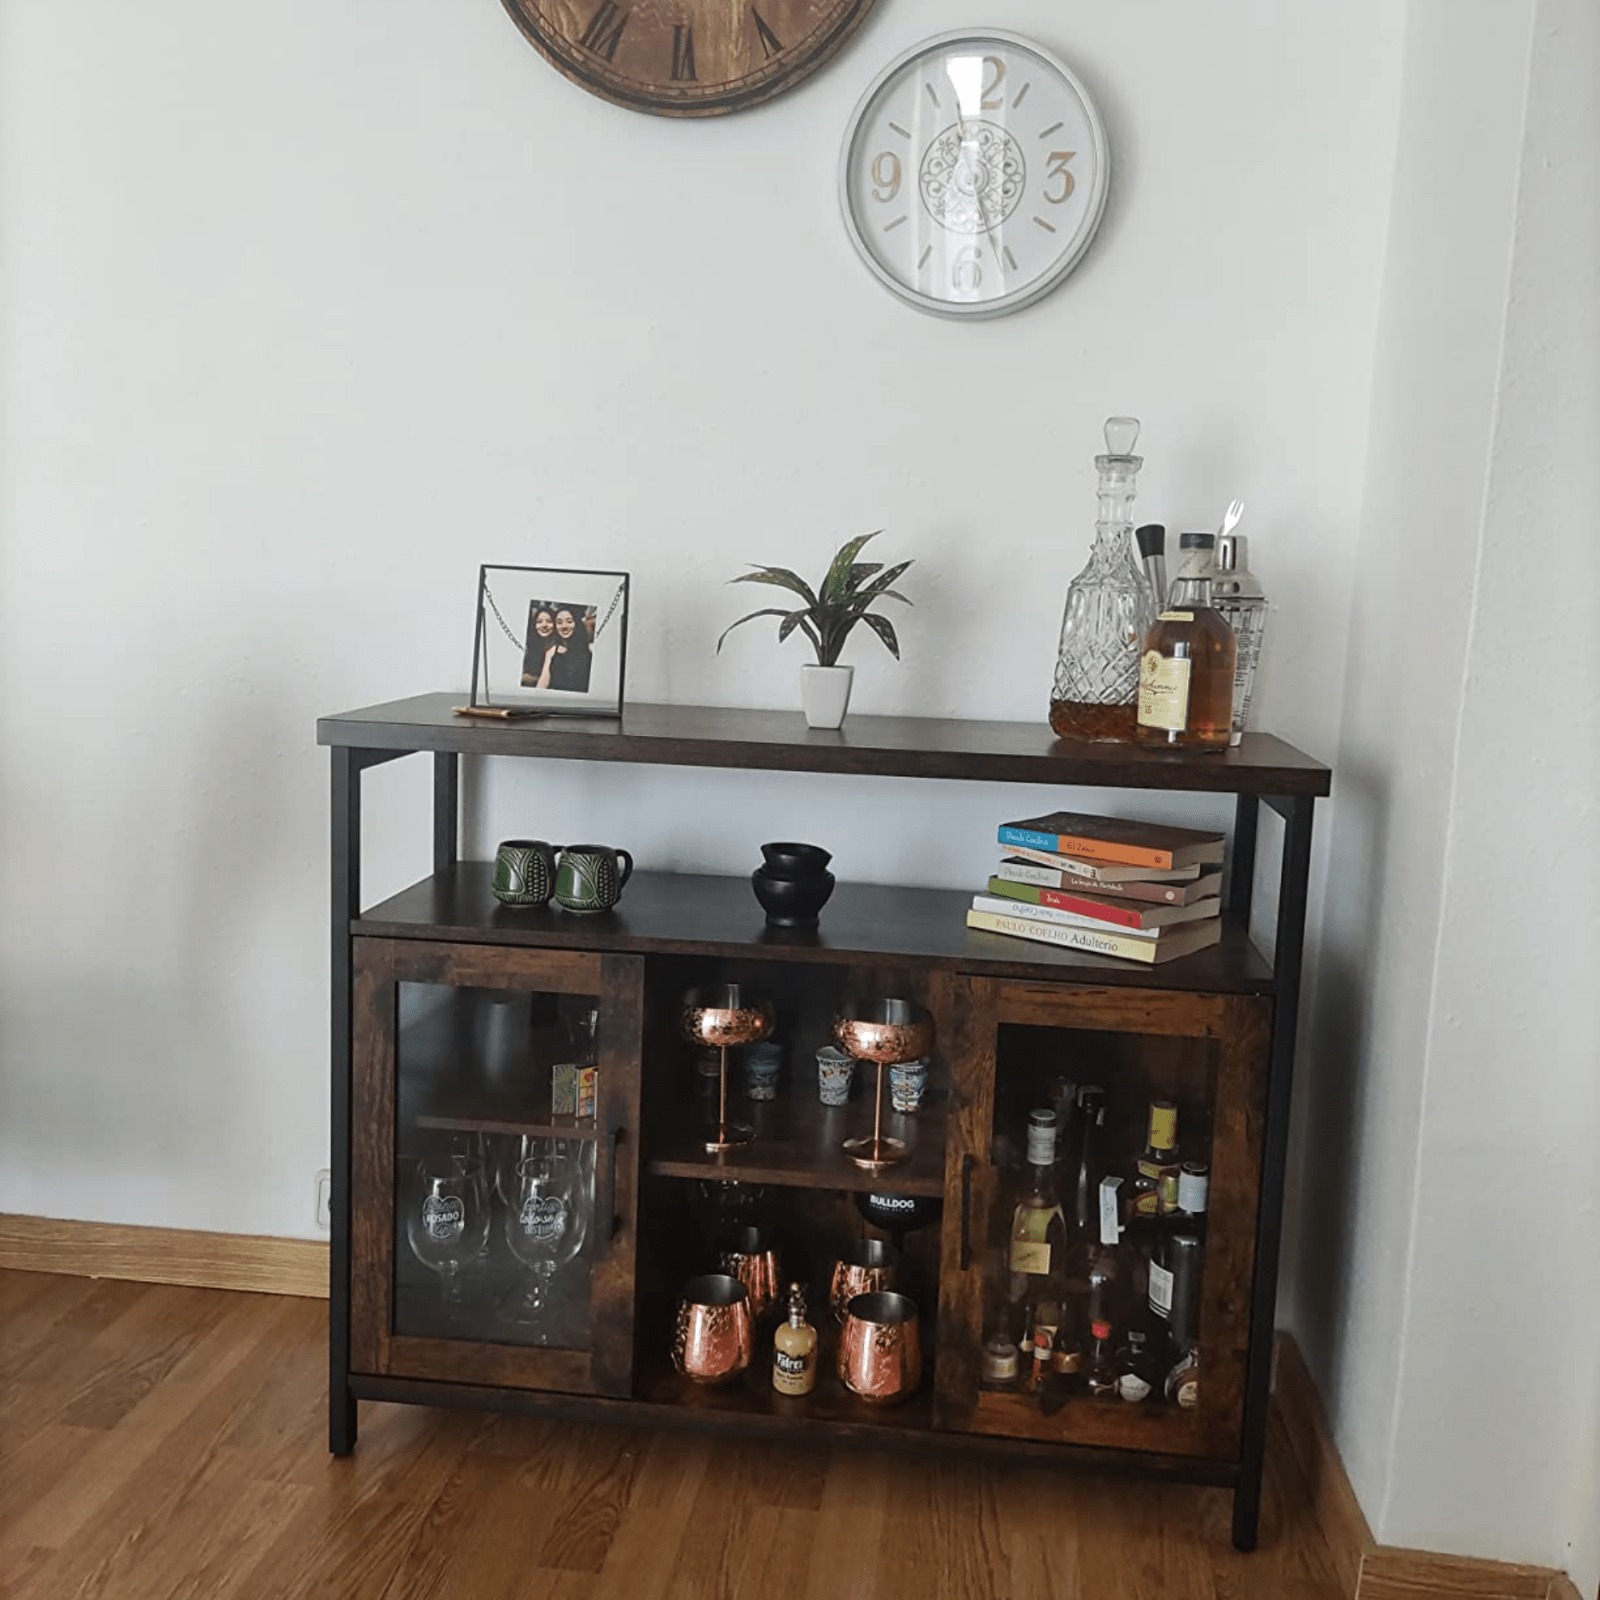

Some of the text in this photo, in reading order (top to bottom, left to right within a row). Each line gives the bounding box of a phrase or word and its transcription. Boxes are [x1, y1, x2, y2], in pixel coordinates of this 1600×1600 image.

[871, 151, 902, 204] 9
[1043, 150, 1077, 204] 3
[951, 245, 983, 295] 6
[996, 918, 1119, 953] PAULO COELHO Adulterio
[870, 1194, 915, 1209] BULLDOG
